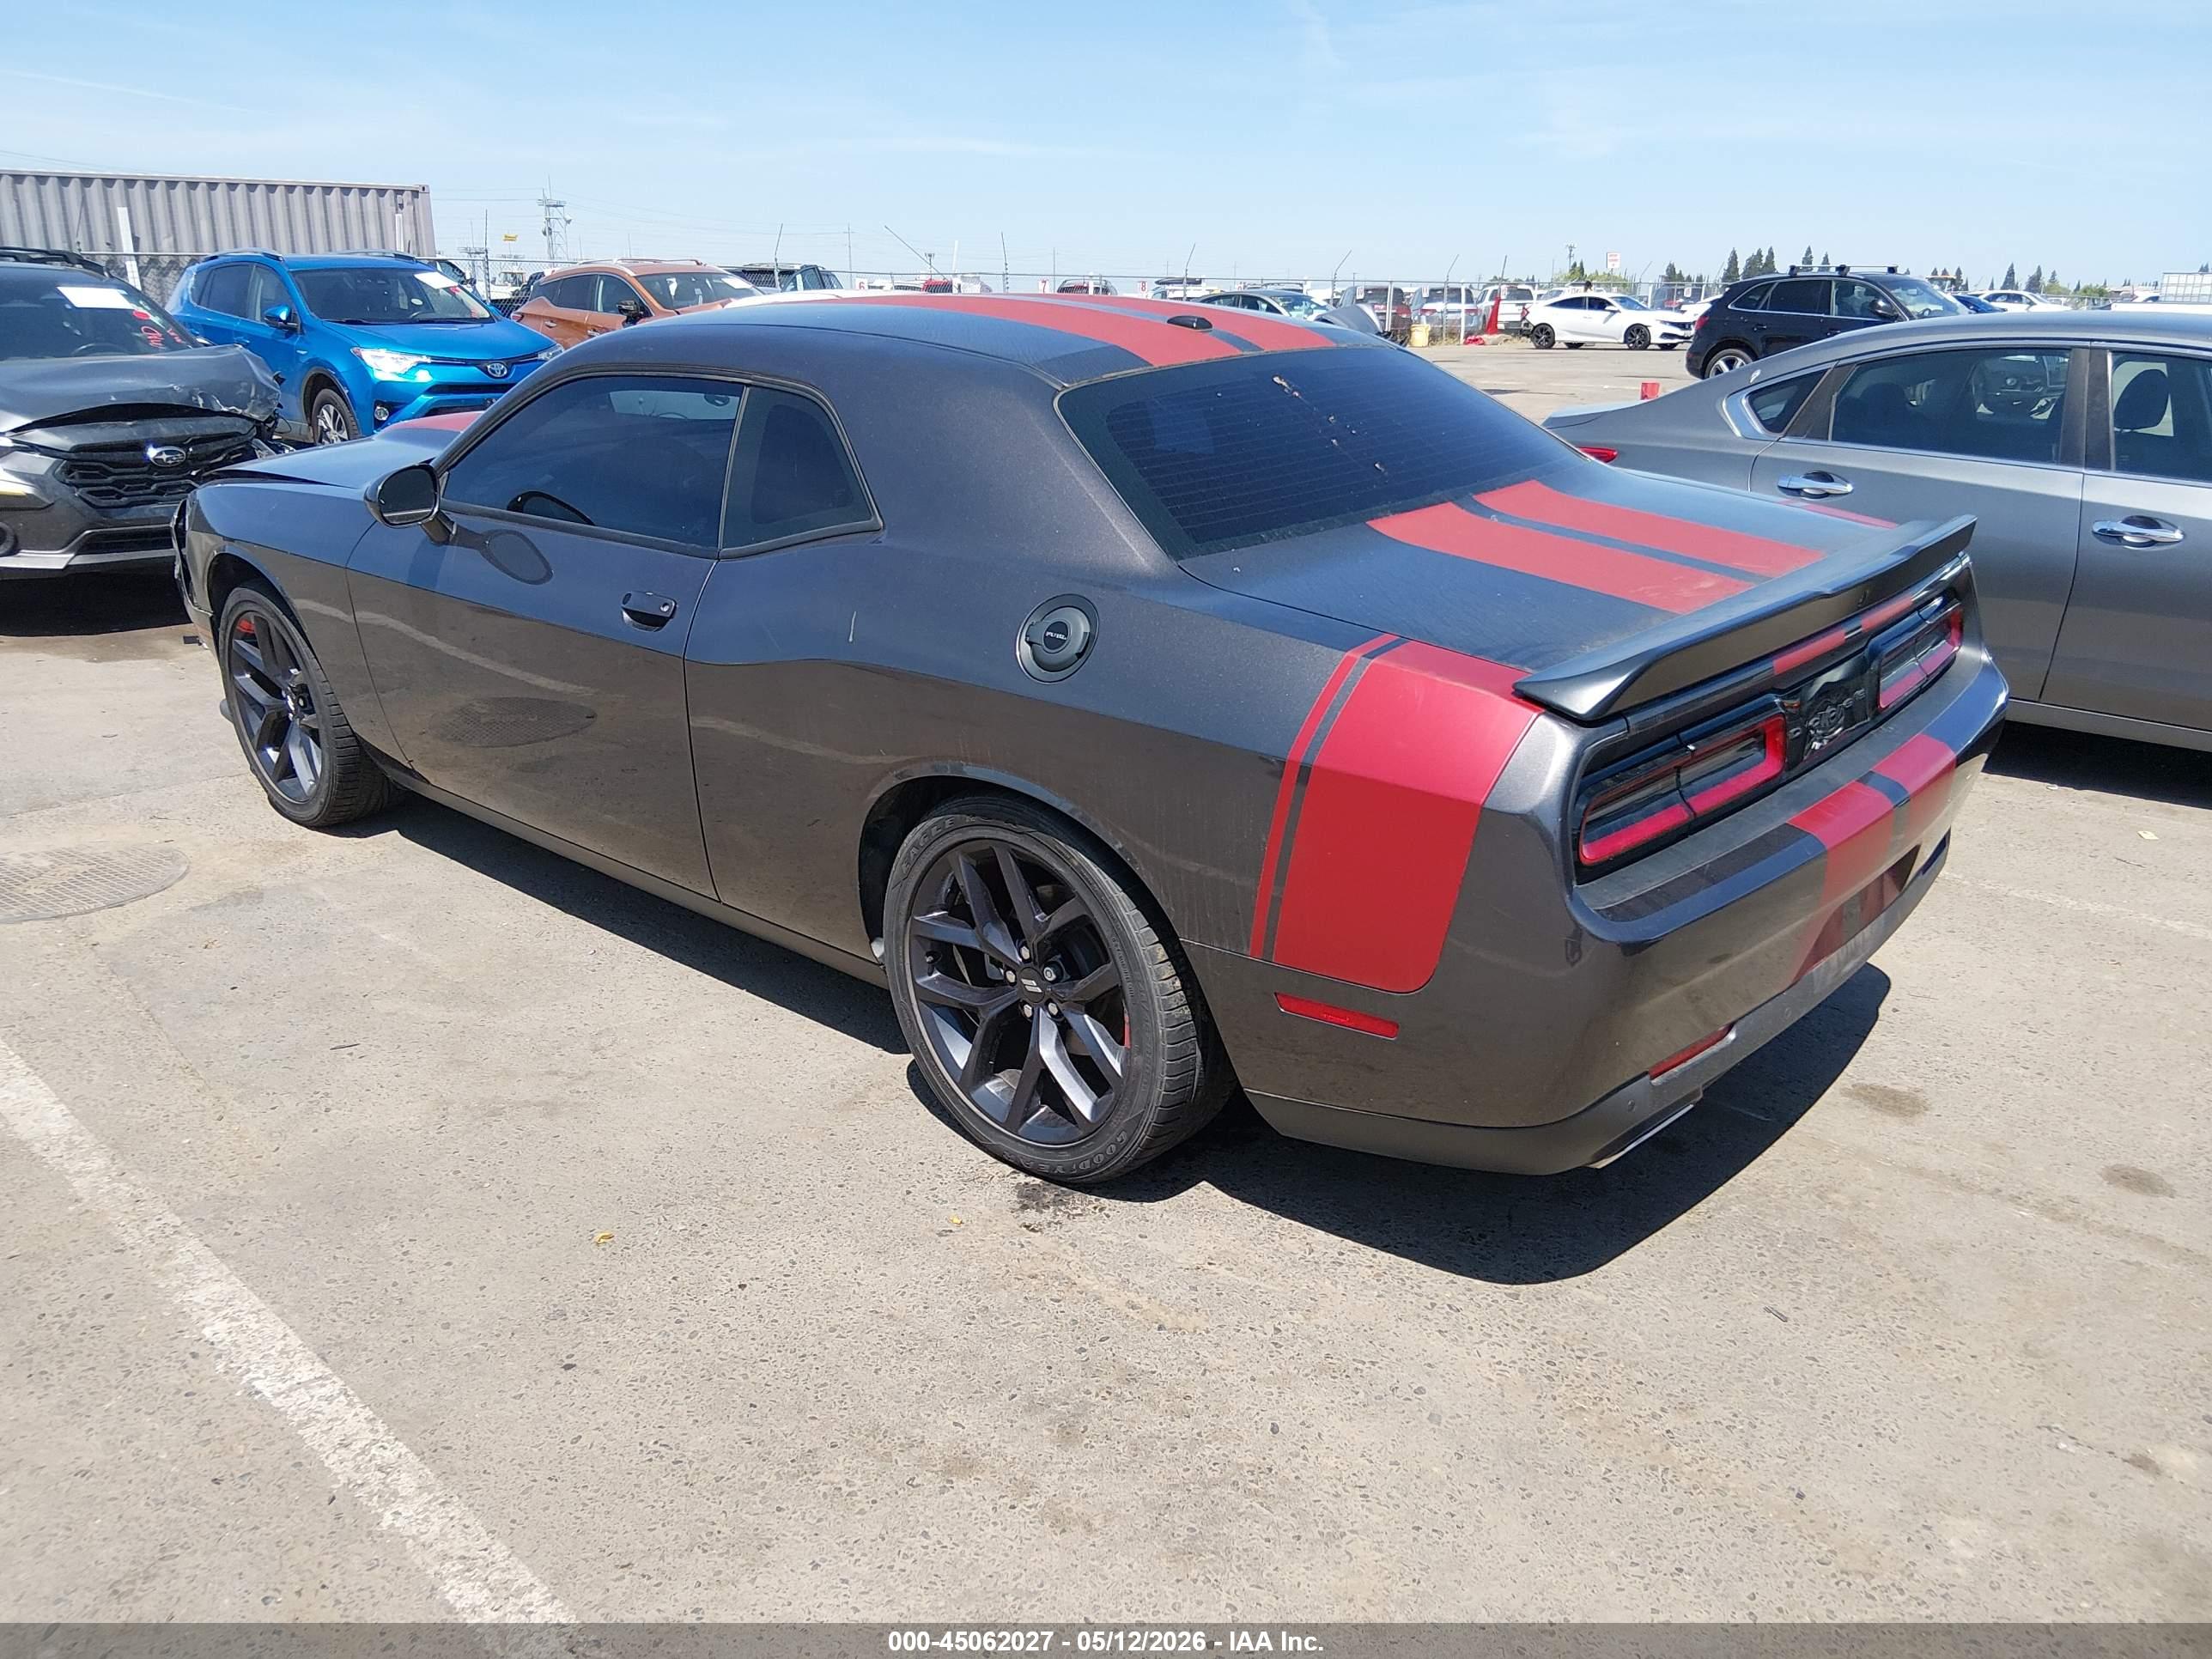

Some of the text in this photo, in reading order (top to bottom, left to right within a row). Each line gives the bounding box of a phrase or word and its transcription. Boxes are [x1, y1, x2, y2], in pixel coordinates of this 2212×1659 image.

[1042, 279, 1048, 293] 7
[1140, 281, 1147, 292] 8
[901, 816, 956, 874] EAGLE
